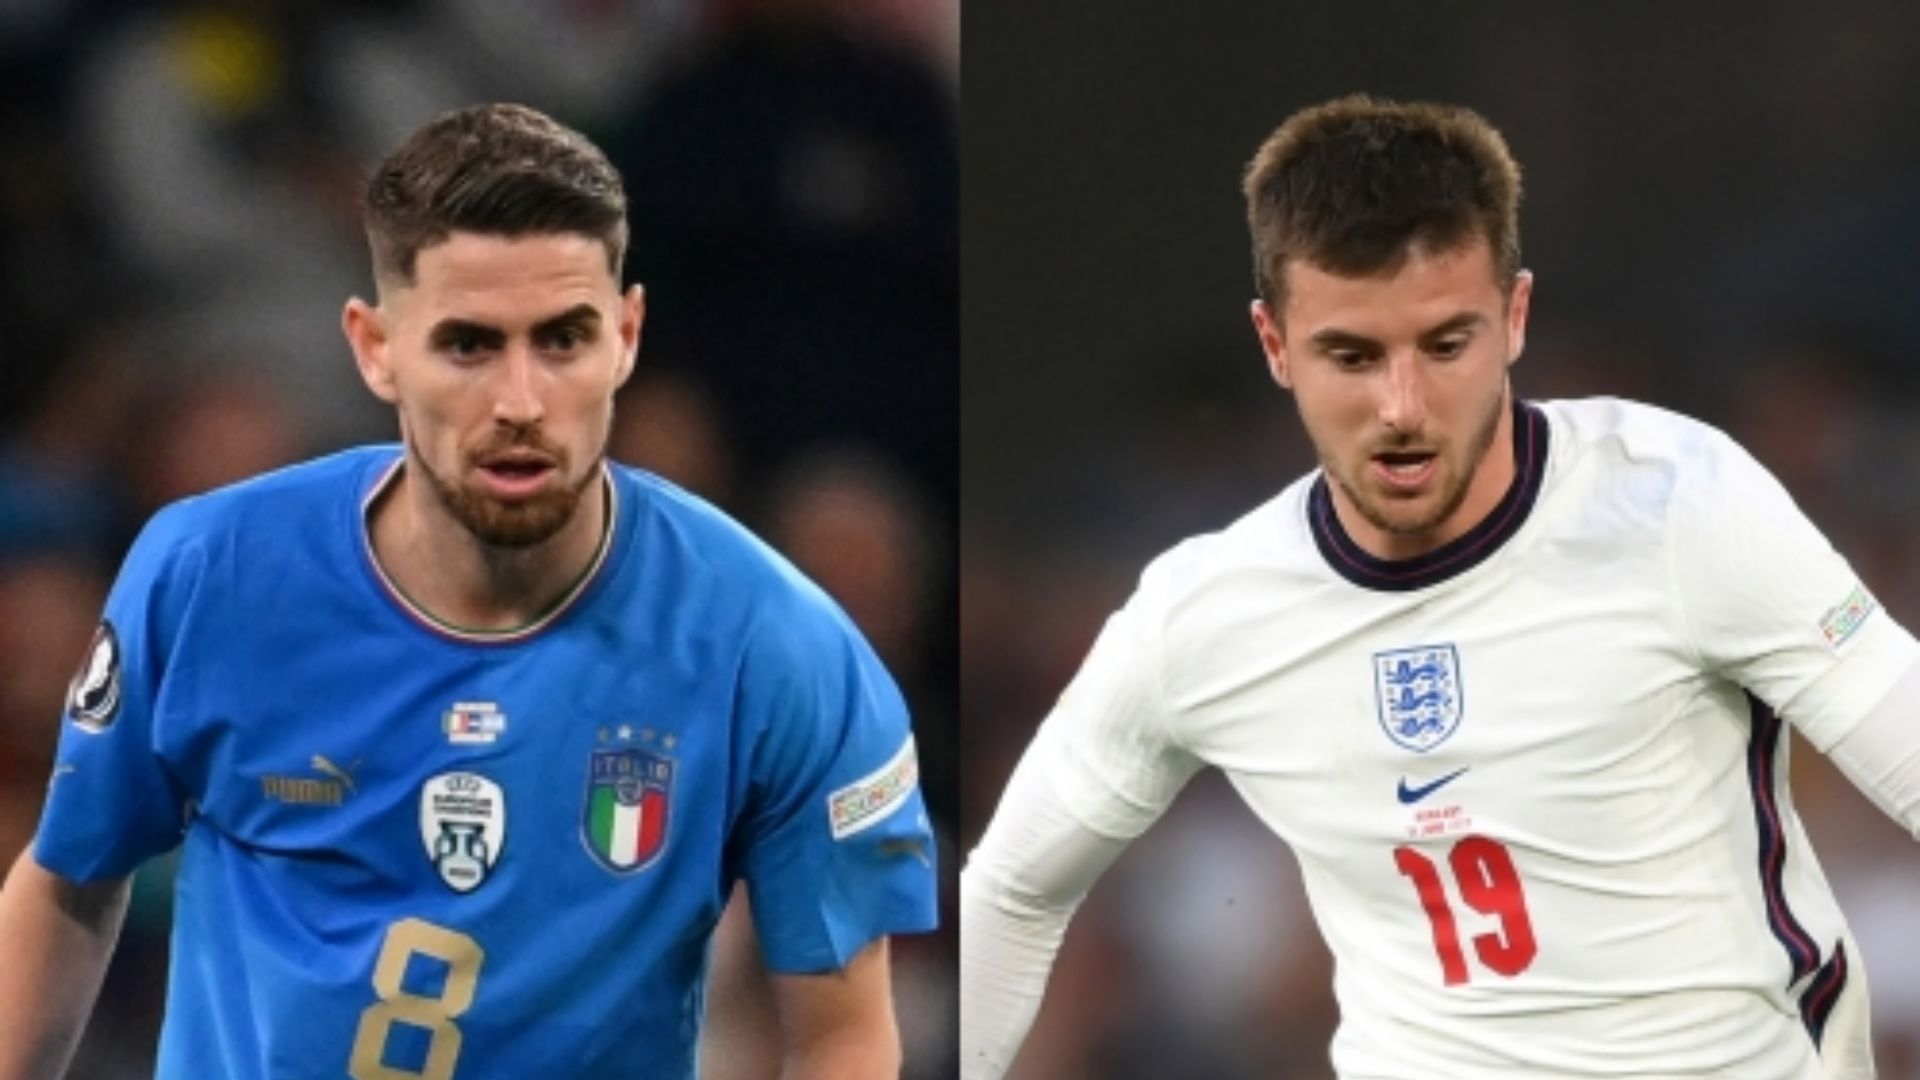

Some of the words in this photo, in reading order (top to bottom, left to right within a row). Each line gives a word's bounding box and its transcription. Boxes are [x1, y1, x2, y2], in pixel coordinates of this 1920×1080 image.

[262, 773, 342, 804] PUMA
[594, 755, 670, 780] ITALIA
[1393, 834, 1537, 986] 19
[348, 917, 484, 1080] 8
